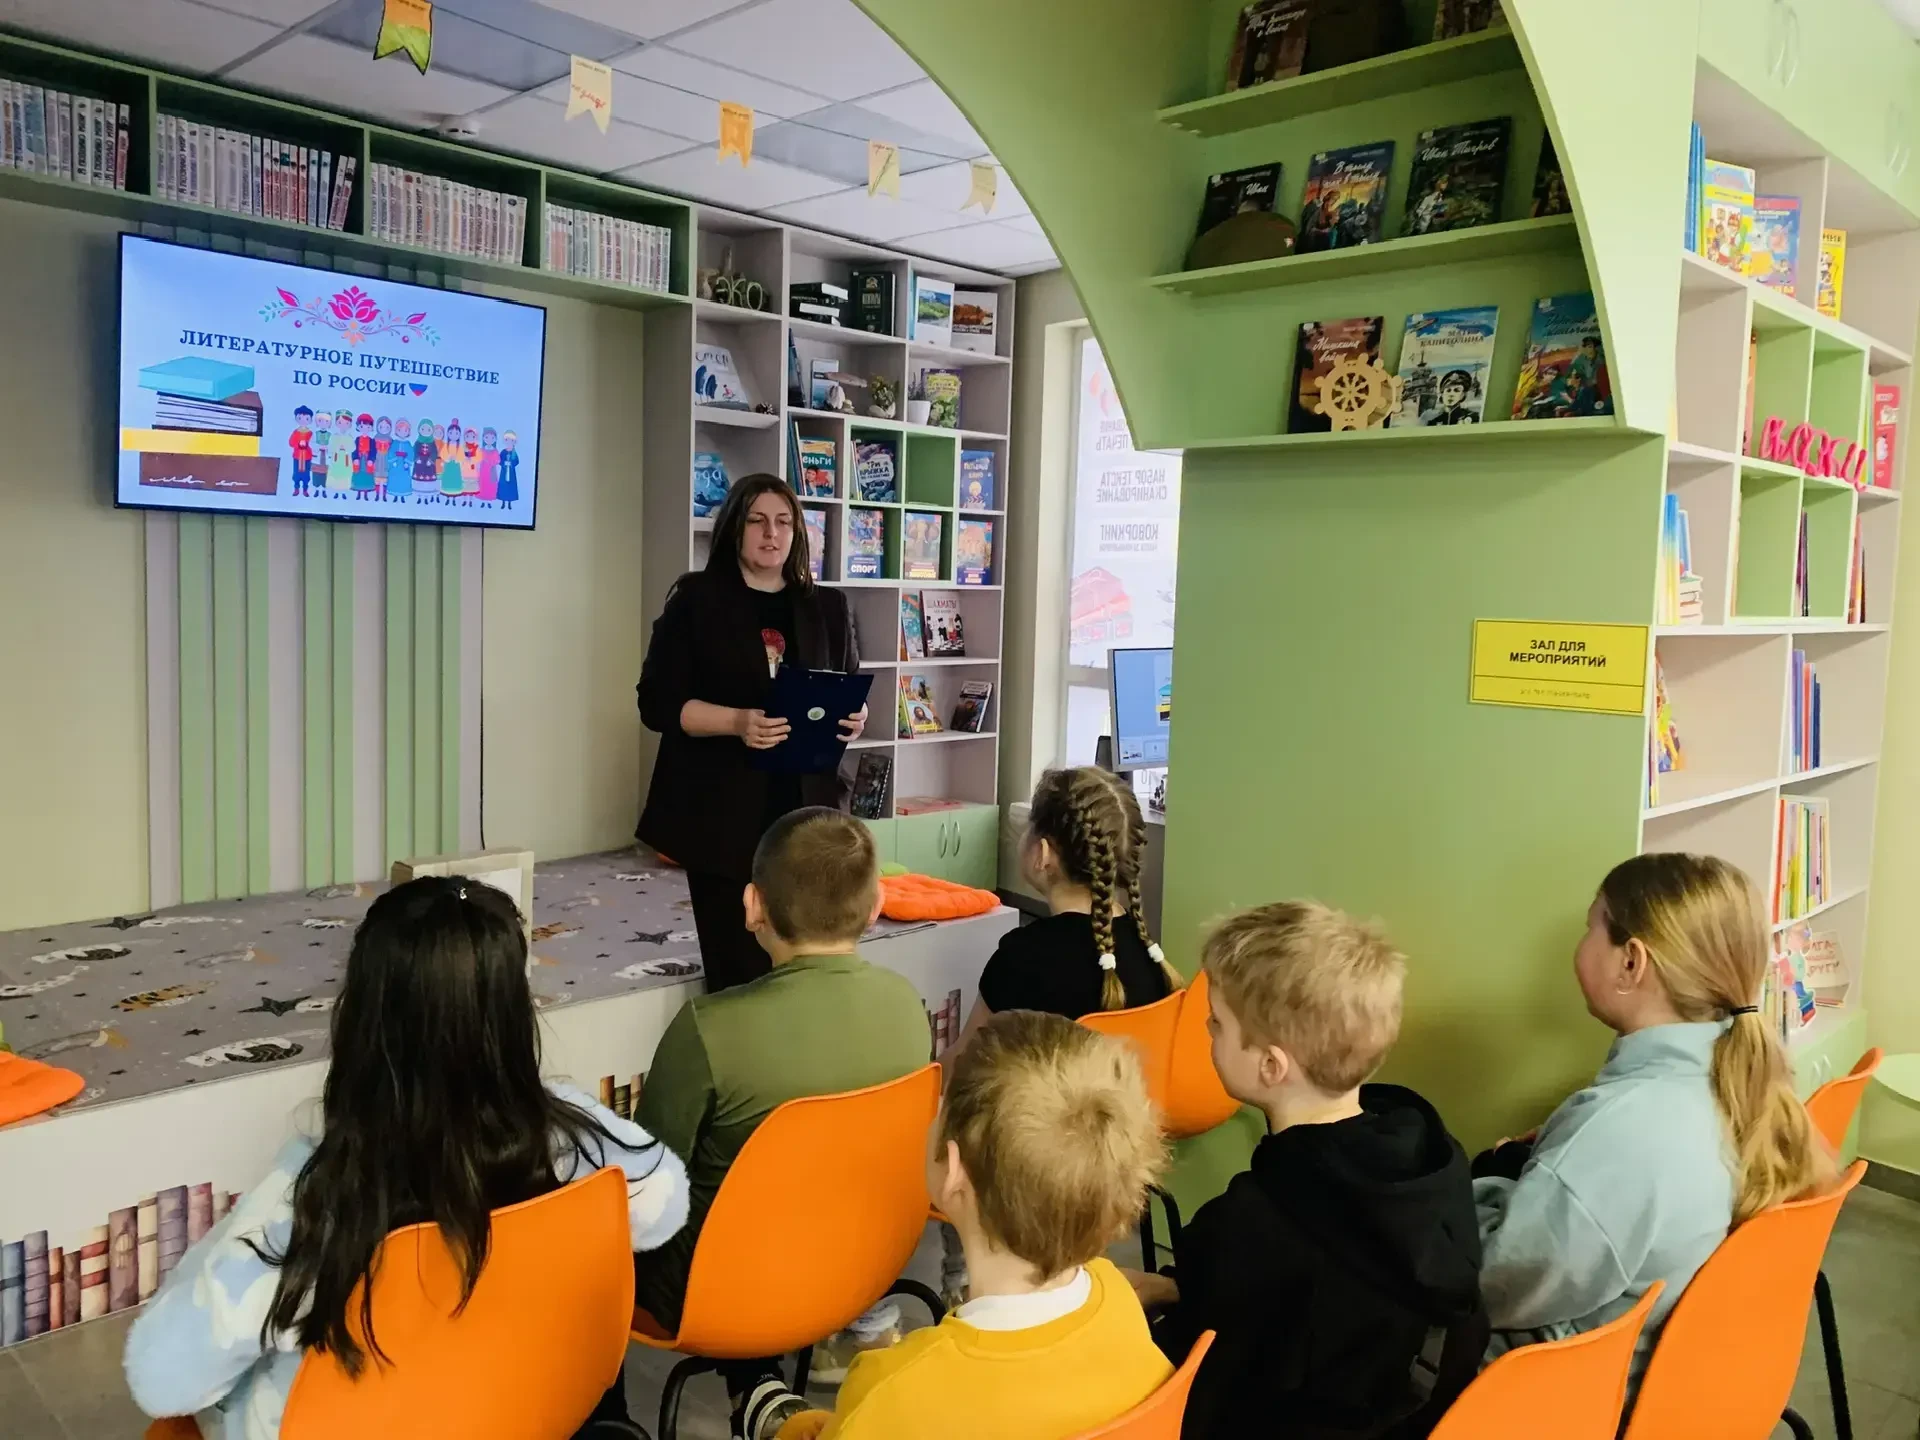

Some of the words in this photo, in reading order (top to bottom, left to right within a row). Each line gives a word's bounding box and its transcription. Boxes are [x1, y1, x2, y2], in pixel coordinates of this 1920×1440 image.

[179, 328, 353, 367] ЛИТЕРАТУРНОЕ
[359, 352, 500, 385] ПУТЕШЕСТВИЕ
[293, 370, 322, 387] ПО
[328, 374, 406, 396] РОССИИ
[803, 456, 832, 466] еньги
[851, 564, 877, 573] СПОРТ
[1530, 639, 1555, 650] ЗАЛ
[1558, 641, 1586, 652] ДЛЯ
[1509, 652, 1606, 667] МЕРОПРИЯТИЙ
